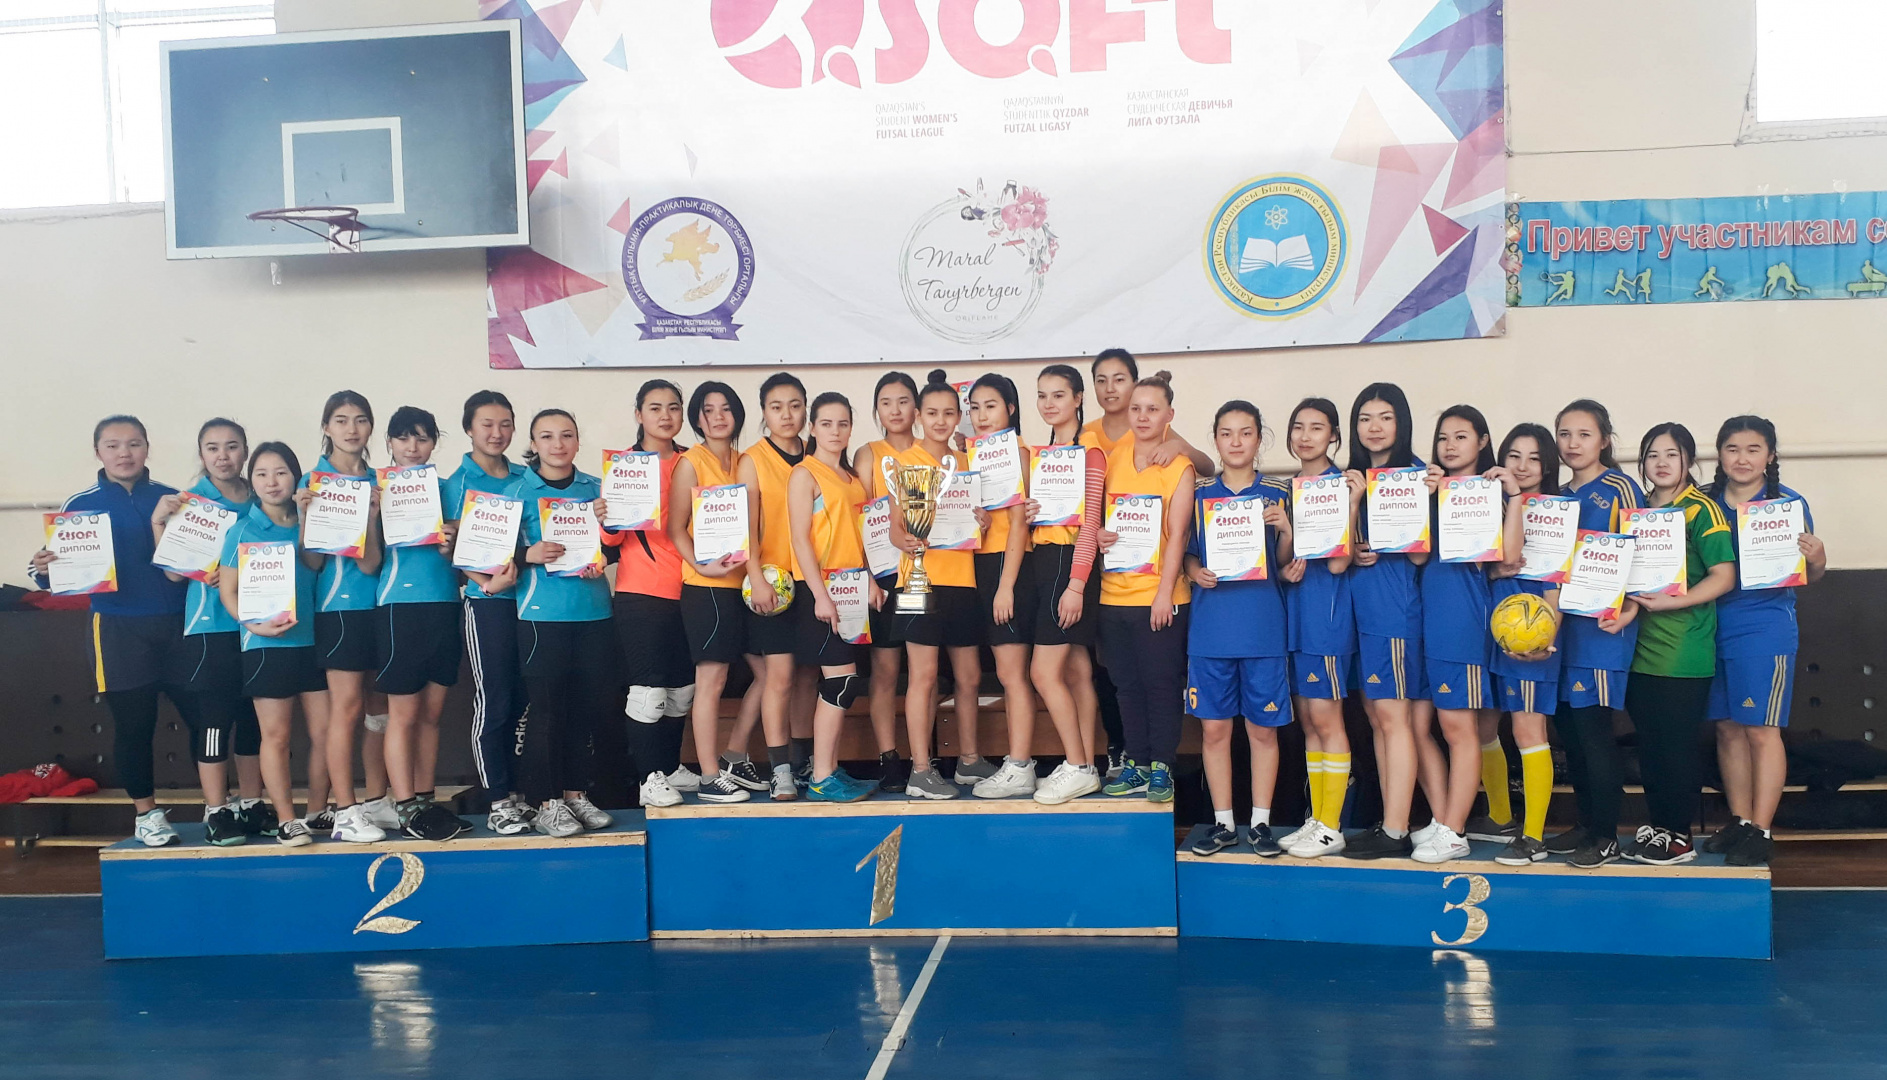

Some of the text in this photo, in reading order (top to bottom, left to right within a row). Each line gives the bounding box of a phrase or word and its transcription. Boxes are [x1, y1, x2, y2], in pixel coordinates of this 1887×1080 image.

[1127, 88, 1189, 101] КАЗАХСТАНСКАЯ
[1127, 99, 1233, 115] СТУДЕНЧЕСКАЯ ДЕВИЧЬЯ
[876, 113, 958, 126] STUDENT WOMEN'S
[1052, 107, 1089, 120] QYZDAR
[1127, 114, 1200, 128] ЛИГА ФУТЗАЛА
[876, 126, 944, 139] FUTSAL LEAGUE
[1004, 121, 1071, 134] FUTZAL LIGASY
[700, 202, 723, 218] ДЕНЕ
[1526, 217, 1887, 260] Привет участникам с
[914, 243, 996, 268] Maral
[918, 276, 1022, 312] Tanyrbergen
[980, 461, 1012, 472] ДИПЛОМ
[613, 482, 649, 490] ДИПЛОМ
[392, 497, 429, 507] ДИПЛОМ
[937, 502, 971, 510] ДИПЛОМ
[1379, 502, 1417, 510] ДИПЛОМ
[319, 504, 357, 516] ДИПЛОМ
[1304, 508, 1339, 518] ДИПЛОМ
[1451, 510, 1490, 518] ДИПЛОМ
[704, 516, 738, 524] ДИПЛОМ
[178, 525, 216, 542] ДИПЛОМ
[471, 524, 508, 536] ДИПЛОМ
[1216, 529, 1253, 539] ДИПЛОМ
[1525, 528, 1564, 539] ДИПЛОМ
[1752, 533, 1792, 545] ДИПЛОМ
[60, 543, 100, 554] ДИПЛОМ
[1634, 542, 1673, 551] ДИПЛОМ
[1579, 564, 1618, 575] ДИПЛОМ
[250, 574, 285, 583] ДИПЛОМ
[855, 824, 903, 926] 1
[353, 852, 425, 935] 2
[1430, 873, 1491, 946] 3
